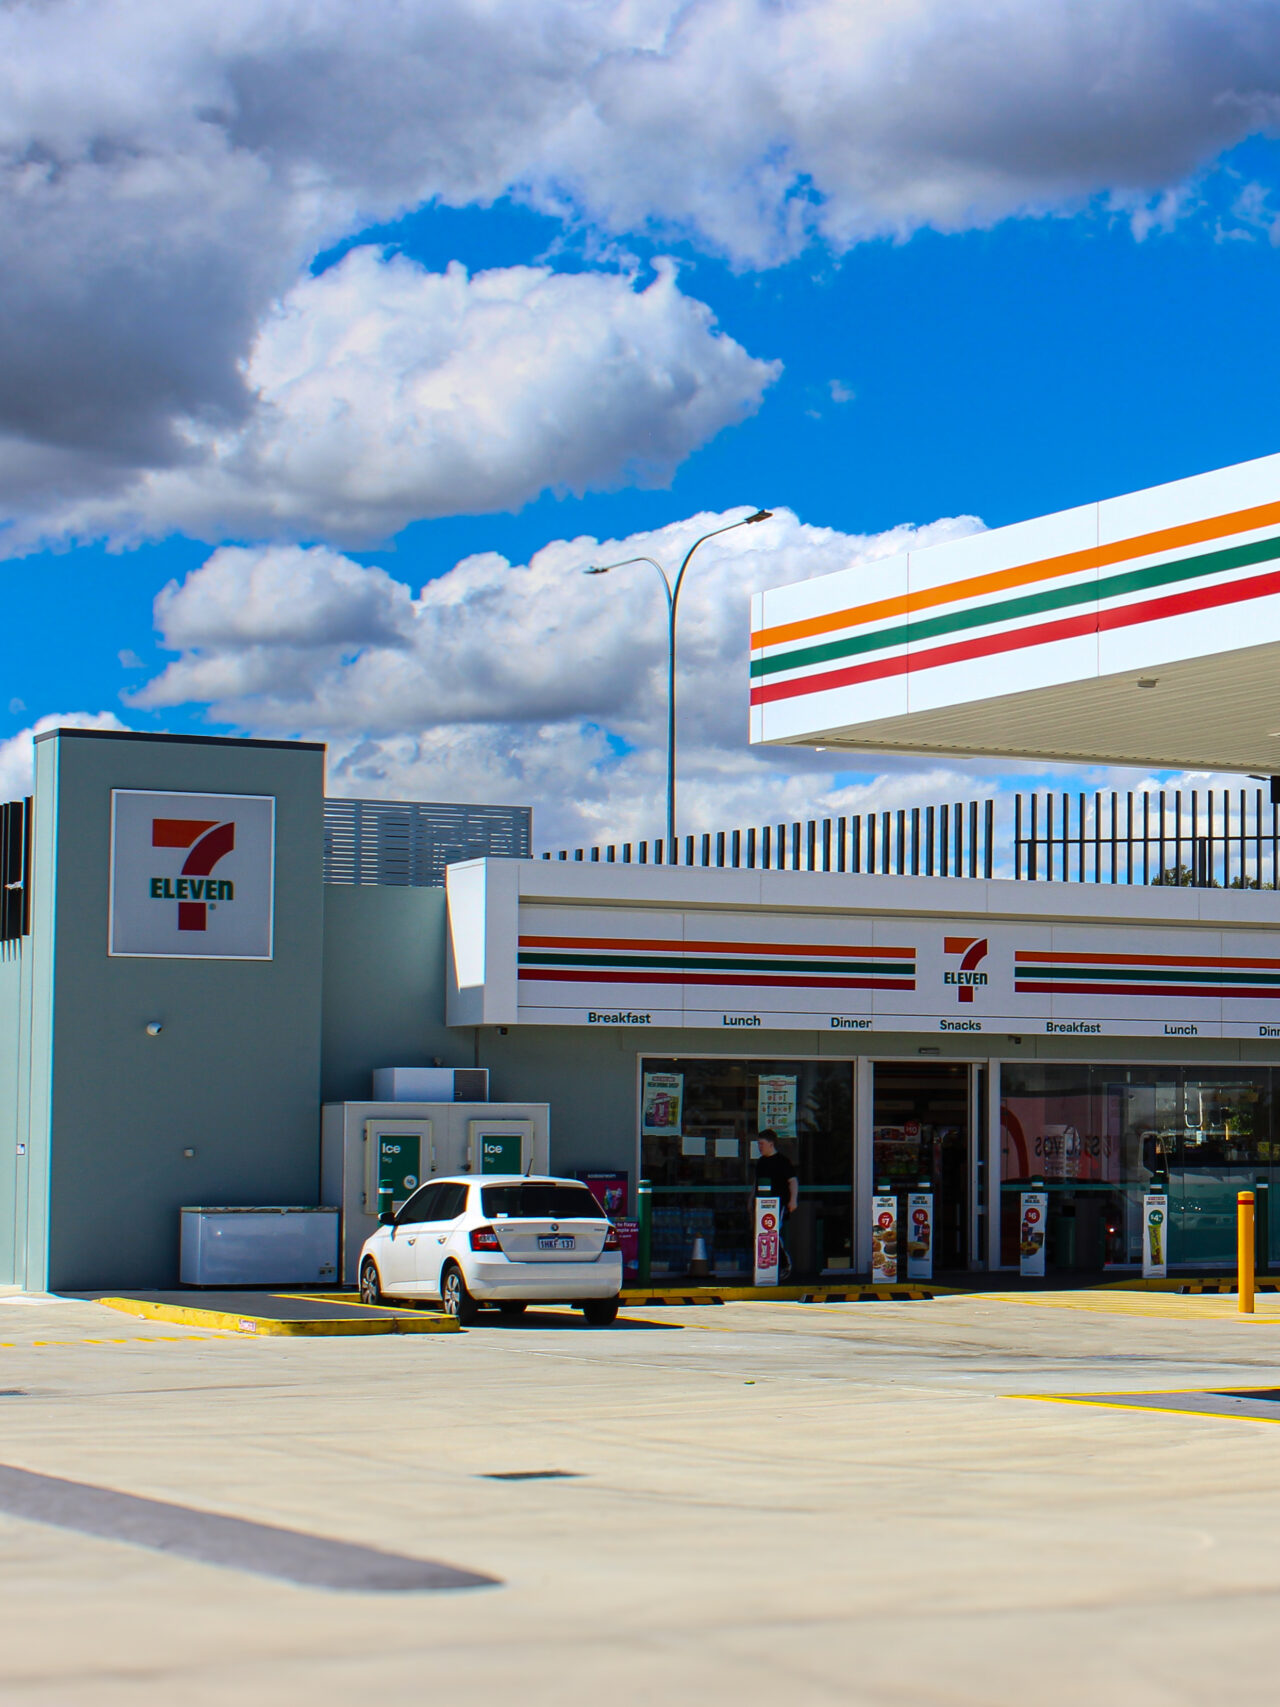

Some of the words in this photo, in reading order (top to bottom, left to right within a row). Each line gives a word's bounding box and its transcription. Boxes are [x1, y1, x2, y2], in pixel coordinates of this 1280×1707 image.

[588, 1012, 651, 1024] Breakfast
[723, 1015, 761, 1026] Lunch
[830, 1016, 872, 1029] Dinner
[939, 1019, 982, 1031] Snacks
[1046, 1021, 1101, 1033] Breakfast
[1164, 1024, 1198, 1035] Lunch
[382, 1142, 401, 1154] Ice
[484, 1143, 503, 1154] Ice
